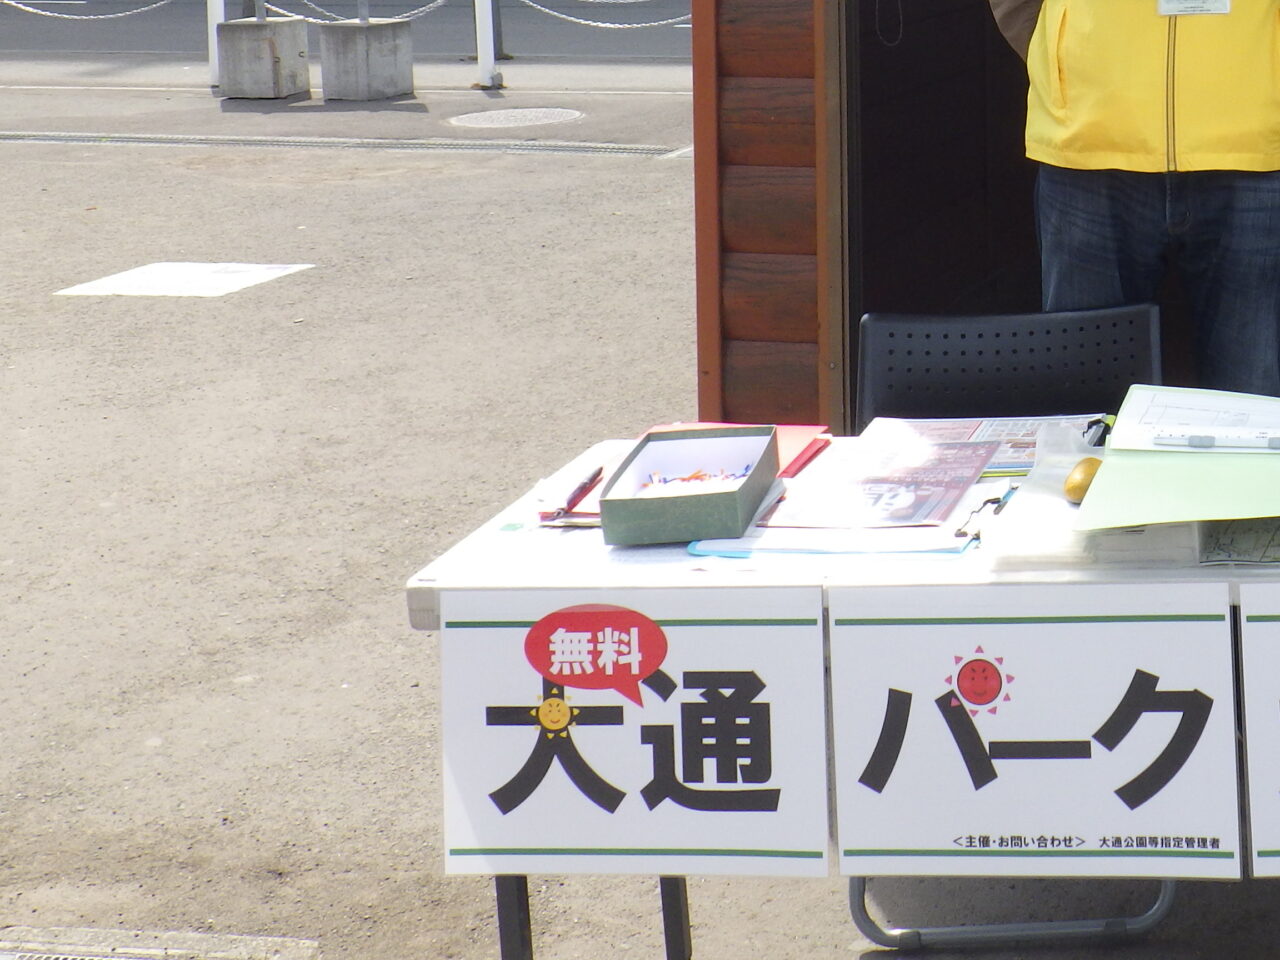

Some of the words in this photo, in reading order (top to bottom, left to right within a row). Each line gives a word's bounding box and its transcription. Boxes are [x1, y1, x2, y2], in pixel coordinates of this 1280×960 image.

[549, 626, 643, 675] 無料
[485, 668, 782, 816] 大通
[857, 658, 1215, 811] パーク
[1098, 836, 1221, 849] 大通公園等指定管理者
